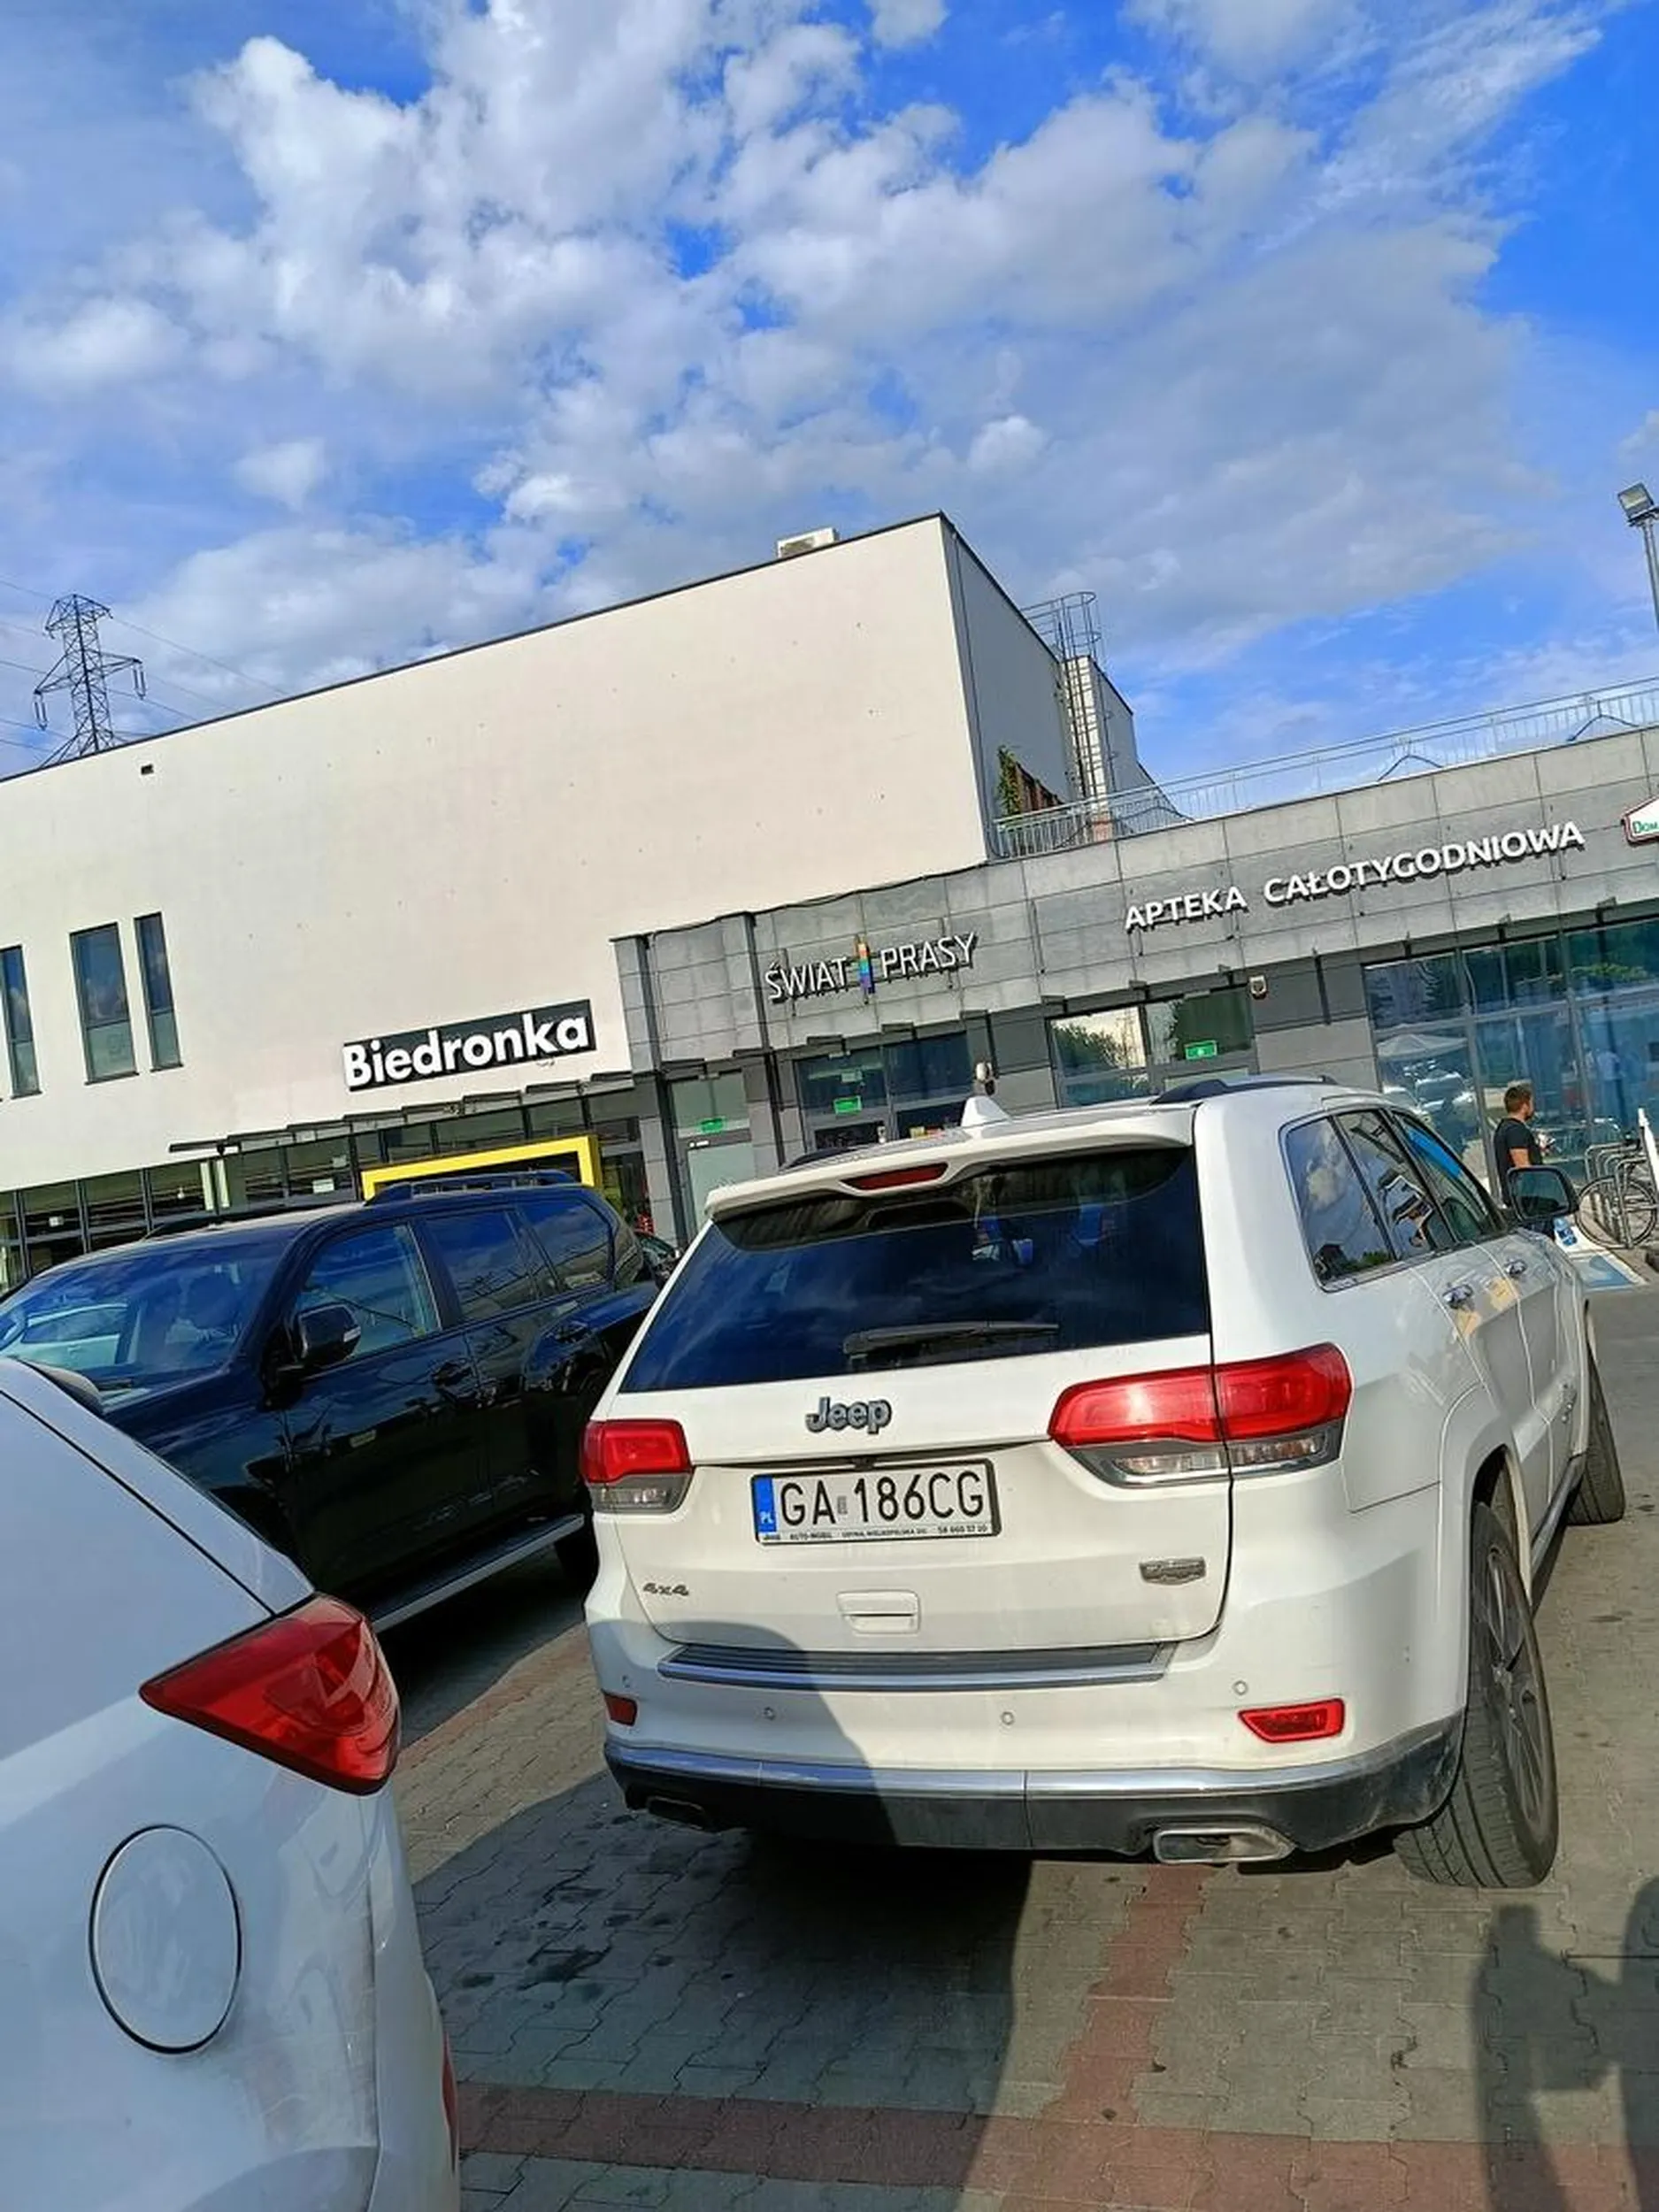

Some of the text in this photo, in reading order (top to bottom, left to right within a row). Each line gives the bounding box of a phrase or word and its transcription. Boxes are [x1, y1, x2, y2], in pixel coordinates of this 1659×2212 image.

[1125, 821, 1586, 929] APTEKA CAŁOTYGODNIOWA
[764, 932, 974, 1000] ŚWIAT PRASY
[342, 1013, 590, 1087] Biedronka
[805, 1396, 892, 1435] Jeep
[780, 1470, 984, 1526] GA 186CG
[642, 1582, 689, 1596] 4x4
